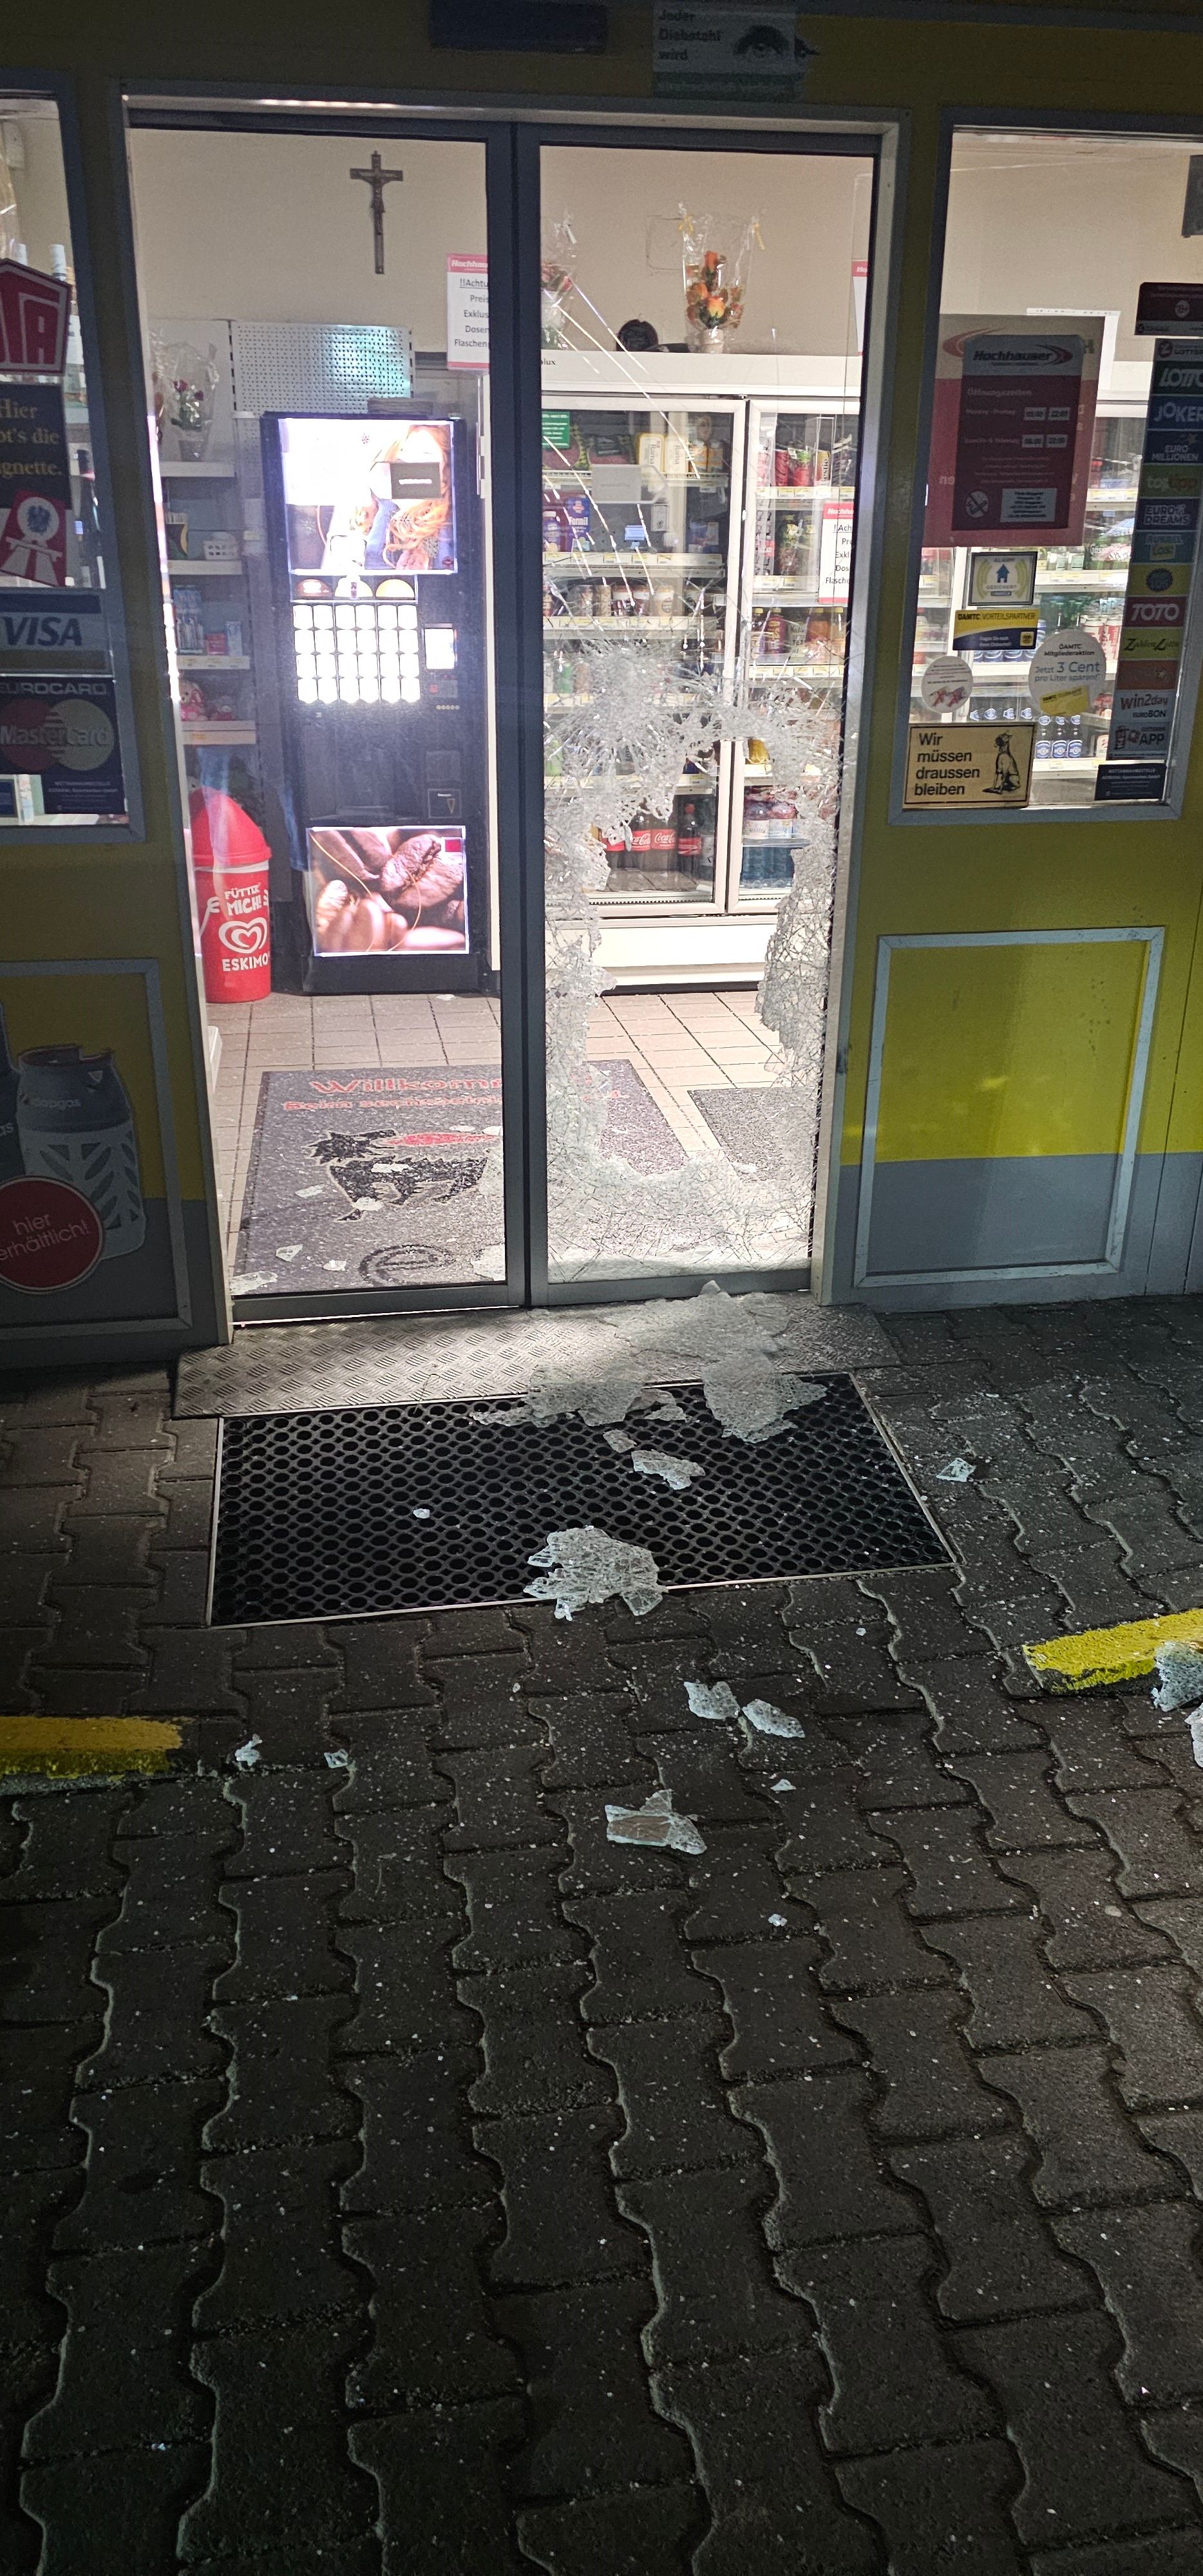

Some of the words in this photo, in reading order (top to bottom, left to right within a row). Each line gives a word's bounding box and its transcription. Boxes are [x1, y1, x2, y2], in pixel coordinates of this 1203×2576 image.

[973, 350, 1052, 361] Hochhauser
[1130, 603, 1180, 621] TOTO
[3, 616, 82, 647] VISA
[1057, 661, 1065, 673] 3
[1068, 661, 1101, 673] Cent
[1120, 693, 1169, 710] win2day
[0, 725, 107, 745] MasterCard
[918, 732, 943, 746] Wir
[1139, 733, 1165, 746] APP
[917, 750, 972, 762] müssen
[916, 766, 980, 779] draussen
[914, 782, 965, 796] bleiben
[227, 895, 262, 916] MICH!
[222, 952, 269, 971] ESKIMO
[13, 1213, 52, 1235] hier
[0, 1219, 89, 1261] erhältlich!
